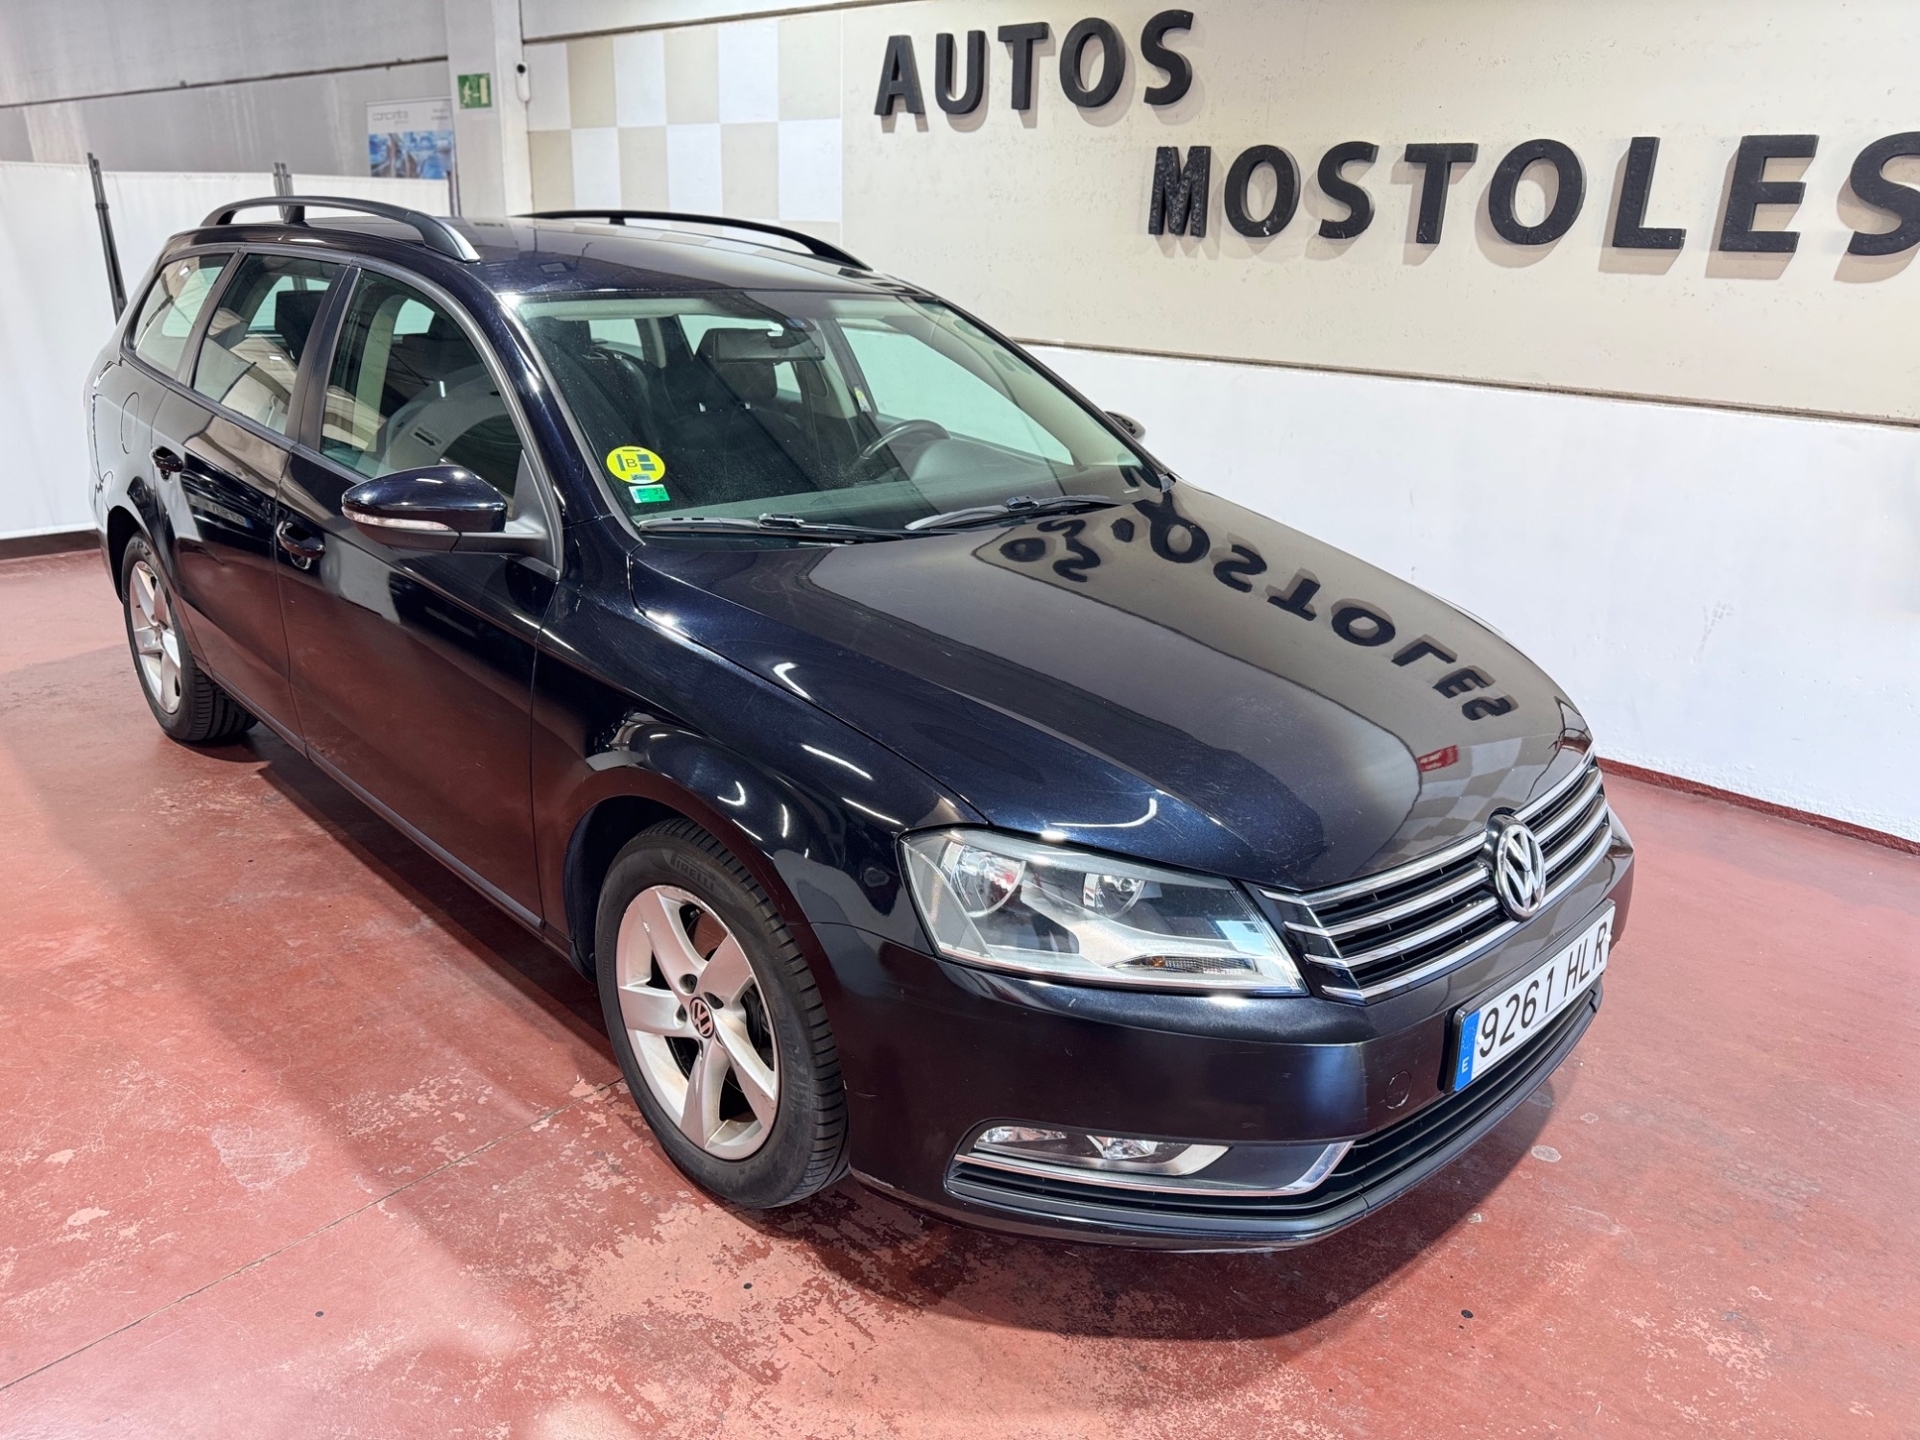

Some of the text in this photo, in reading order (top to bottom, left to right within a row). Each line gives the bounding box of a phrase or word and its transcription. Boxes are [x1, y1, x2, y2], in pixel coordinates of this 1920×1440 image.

[874, 9, 1194, 116] AUTOS
[1148, 131, 1920, 257] MOSTOLES
[670, 853, 716, 891] PIRELLI
[1479, 920, 1609, 1058] 9261 HLR
[1461, 1055, 1470, 1074] E
